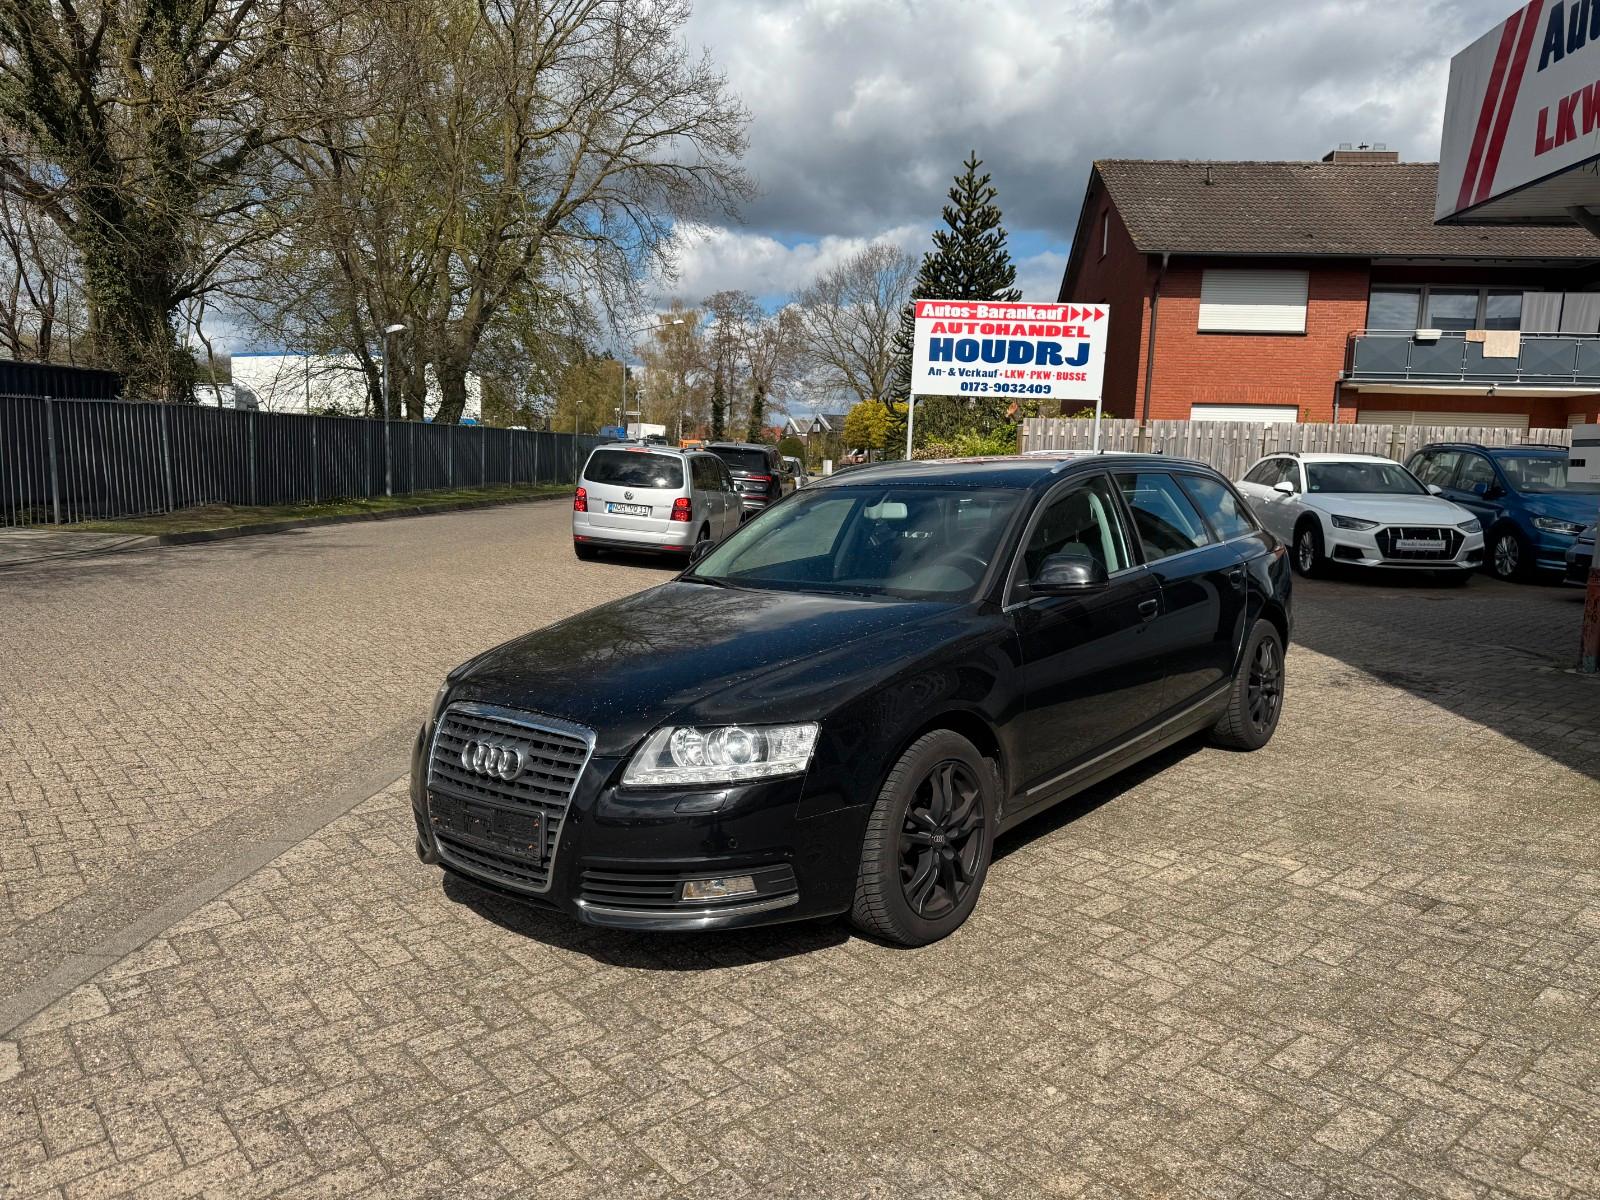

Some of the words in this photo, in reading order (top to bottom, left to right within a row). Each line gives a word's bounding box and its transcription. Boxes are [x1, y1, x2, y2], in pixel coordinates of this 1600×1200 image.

[921, 303, 1064, 320] Autos-Barankauf
[930, 321, 1091, 338] AUTOHANDEL
[928, 337, 1091, 367] HOUDRJ
[928, 367, 946, 376] An-
[947, 367, 956, 377] &
[958, 367, 1000, 378] Verkauf
[1004, 370, 1025, 379] LKW
[1030, 370, 1051, 380] PKW
[1056, 372, 1087, 381] BUSSE
[960, 381, 1052, 394] 0173-9032409
